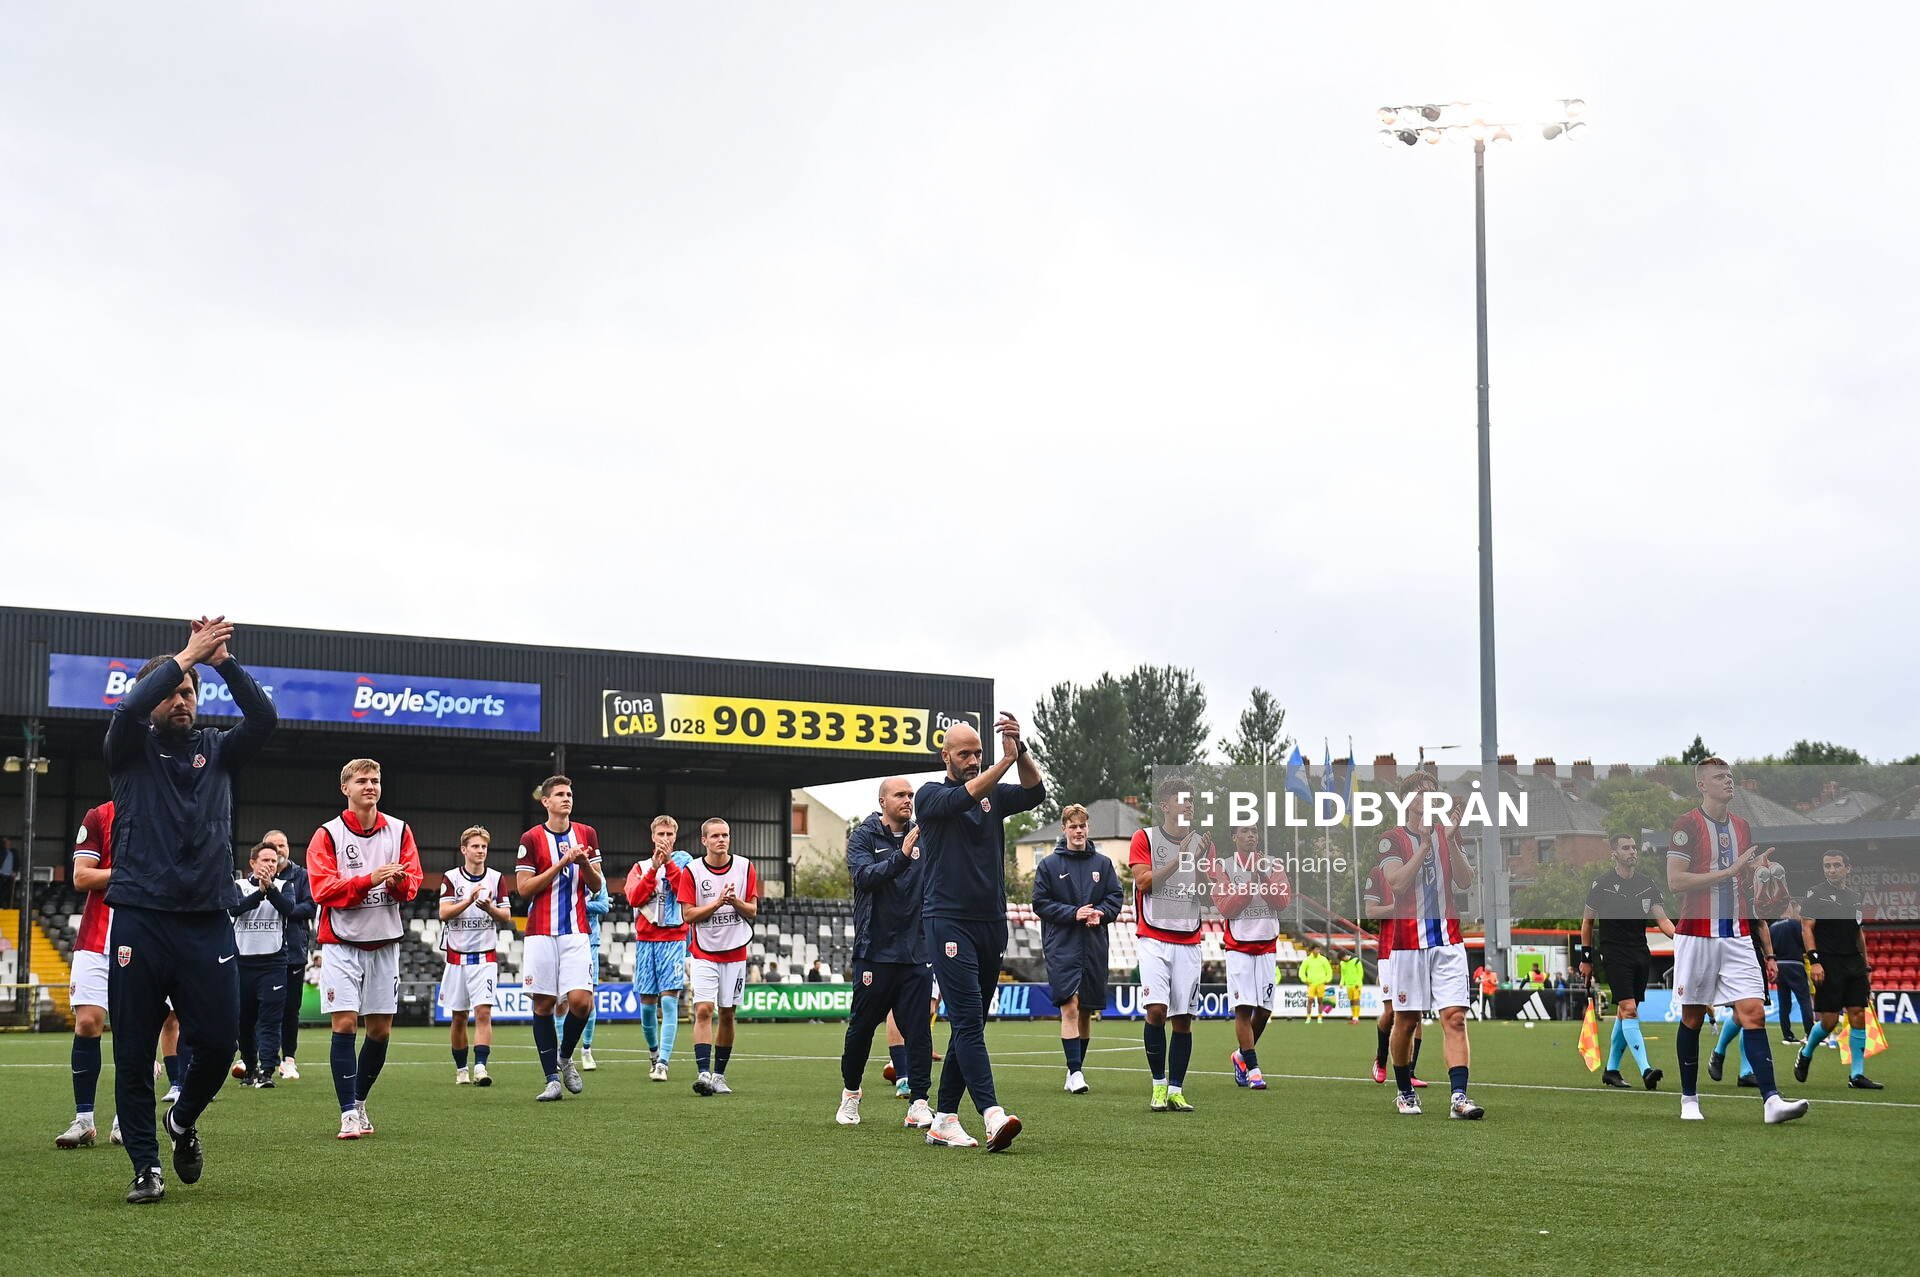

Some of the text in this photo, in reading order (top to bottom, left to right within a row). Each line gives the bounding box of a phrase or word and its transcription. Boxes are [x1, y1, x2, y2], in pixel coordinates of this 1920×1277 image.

[353, 684, 505, 717] BoyleSports
[614, 695, 653, 715] fona
[613, 714, 658, 736] CAB
[670, 718, 705, 735] 028
[713, 705, 766, 736] 90
[777, 708, 845, 742] 333
[855, 713, 921, 746] 333
[935, 711, 970, 730] fon
[1881, 872, 1919, 885] ROAD
[1861, 891, 1917, 906] AVIEW
[733, 977, 744, 994] 18
